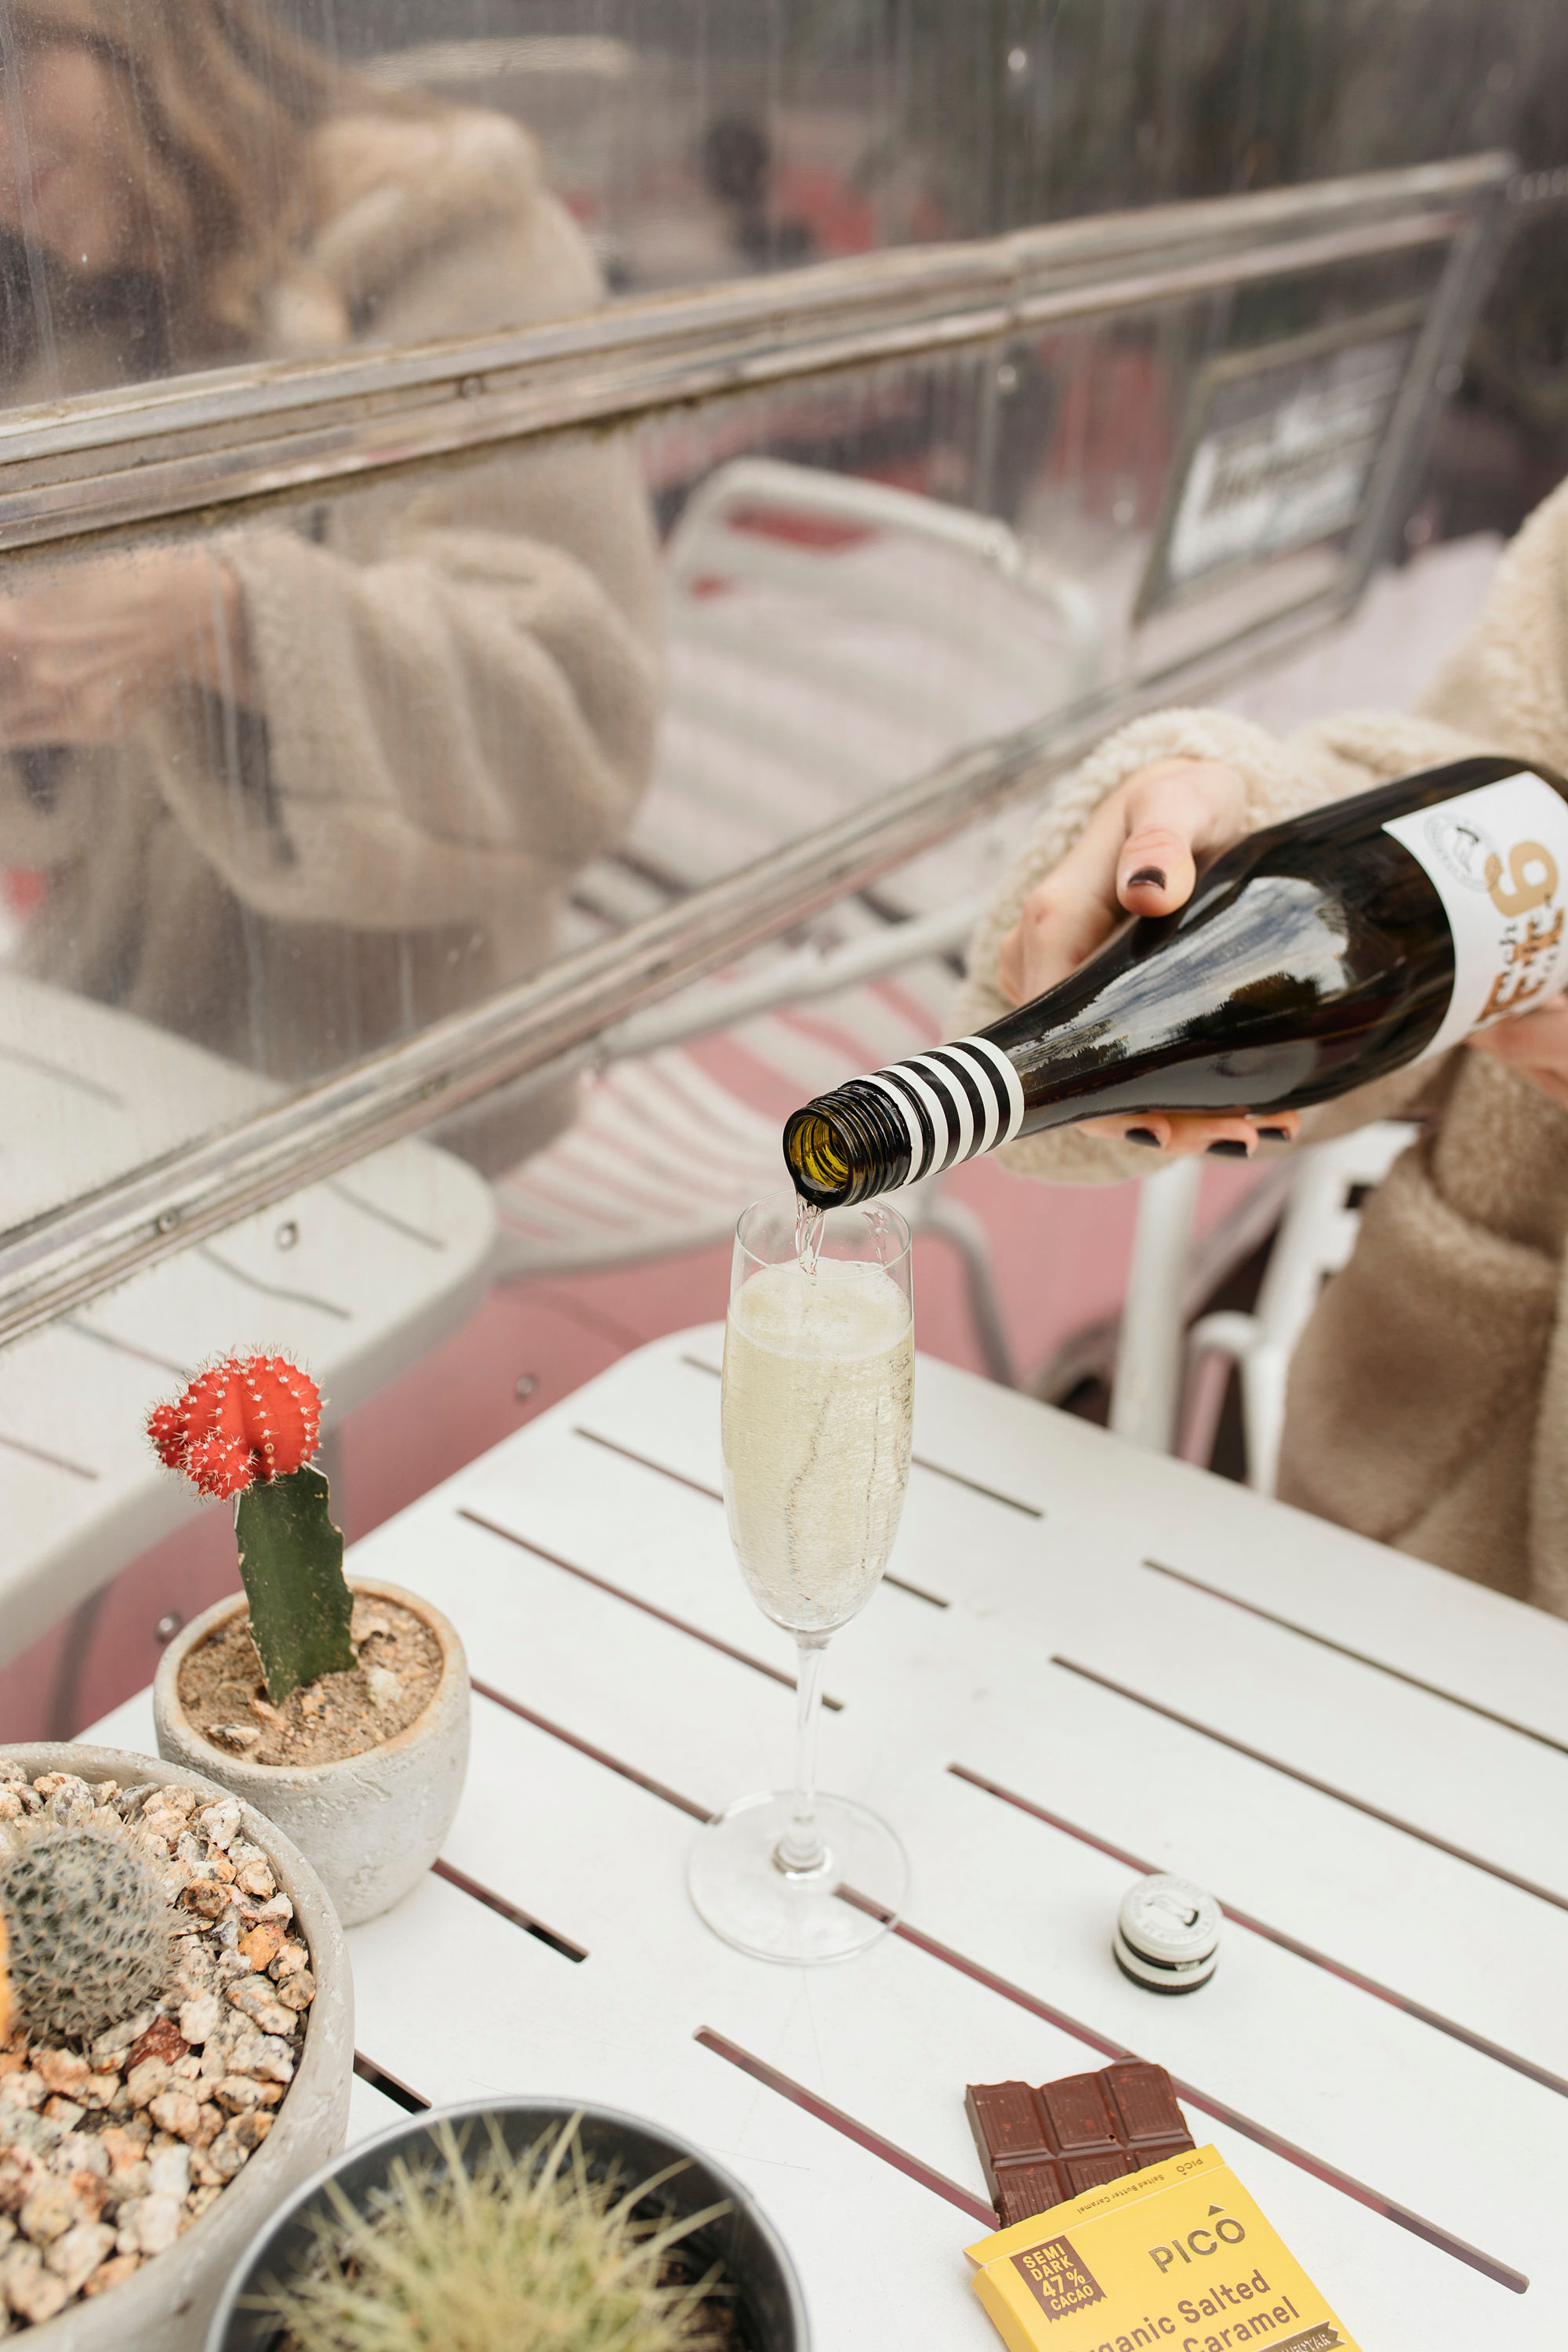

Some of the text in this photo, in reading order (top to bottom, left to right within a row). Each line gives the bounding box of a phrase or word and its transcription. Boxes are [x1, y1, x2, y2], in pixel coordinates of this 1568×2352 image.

[1076, 2158, 1203, 2215] PICÔ Salted Butter Caramel
[1022, 2243, 1065, 2269] SEMI
[1147, 2204, 1246, 2274] PICÔ
[1030, 2256, 1074, 2281] DARK
[1050, 2285, 1094, 2311] CACAO
[1069, 2269, 1272, 2352] anic Salted
[1182, 2296, 1300, 2352] Caramel
